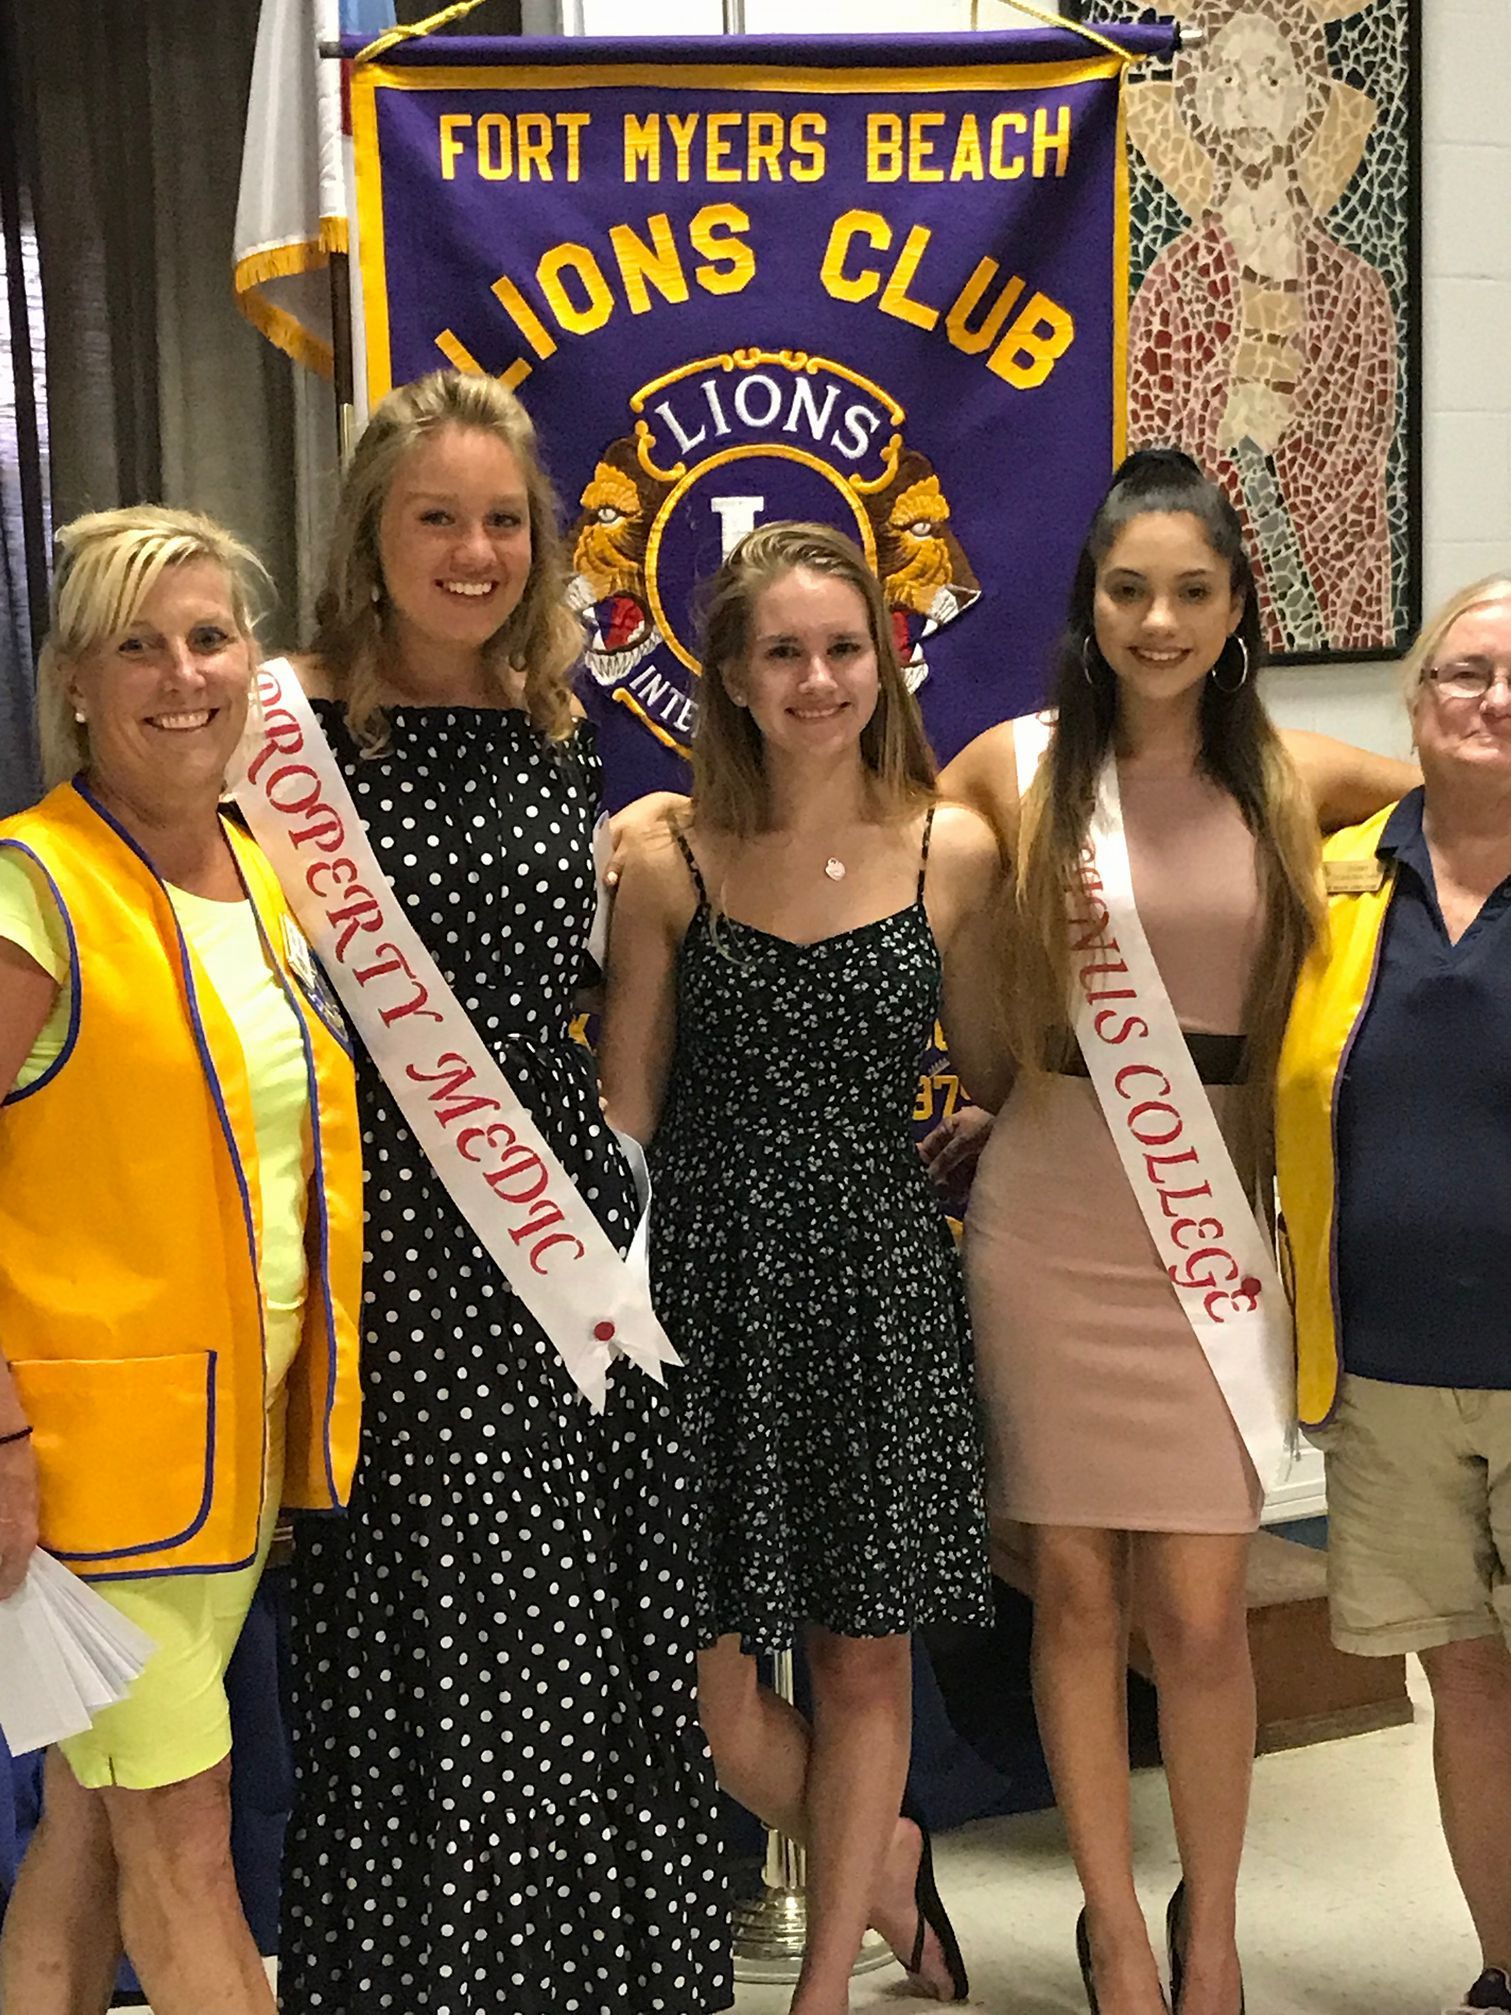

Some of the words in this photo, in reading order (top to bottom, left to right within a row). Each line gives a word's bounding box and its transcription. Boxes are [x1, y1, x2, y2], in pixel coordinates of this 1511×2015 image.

[439, 113, 592, 183] FORT
[623, 112, 827, 183] MYERS
[866, 107, 1072, 183] BEACH
[434, 203, 756, 390] LIONS
[819, 209, 1075, 391] CLUB
[654, 374, 881, 460] LIONS
[629, 664, 700, 738] INTE
[405, 1051, 586, 1276] MEDIC
[1114, 1064, 1260, 1324] COLLEGE
